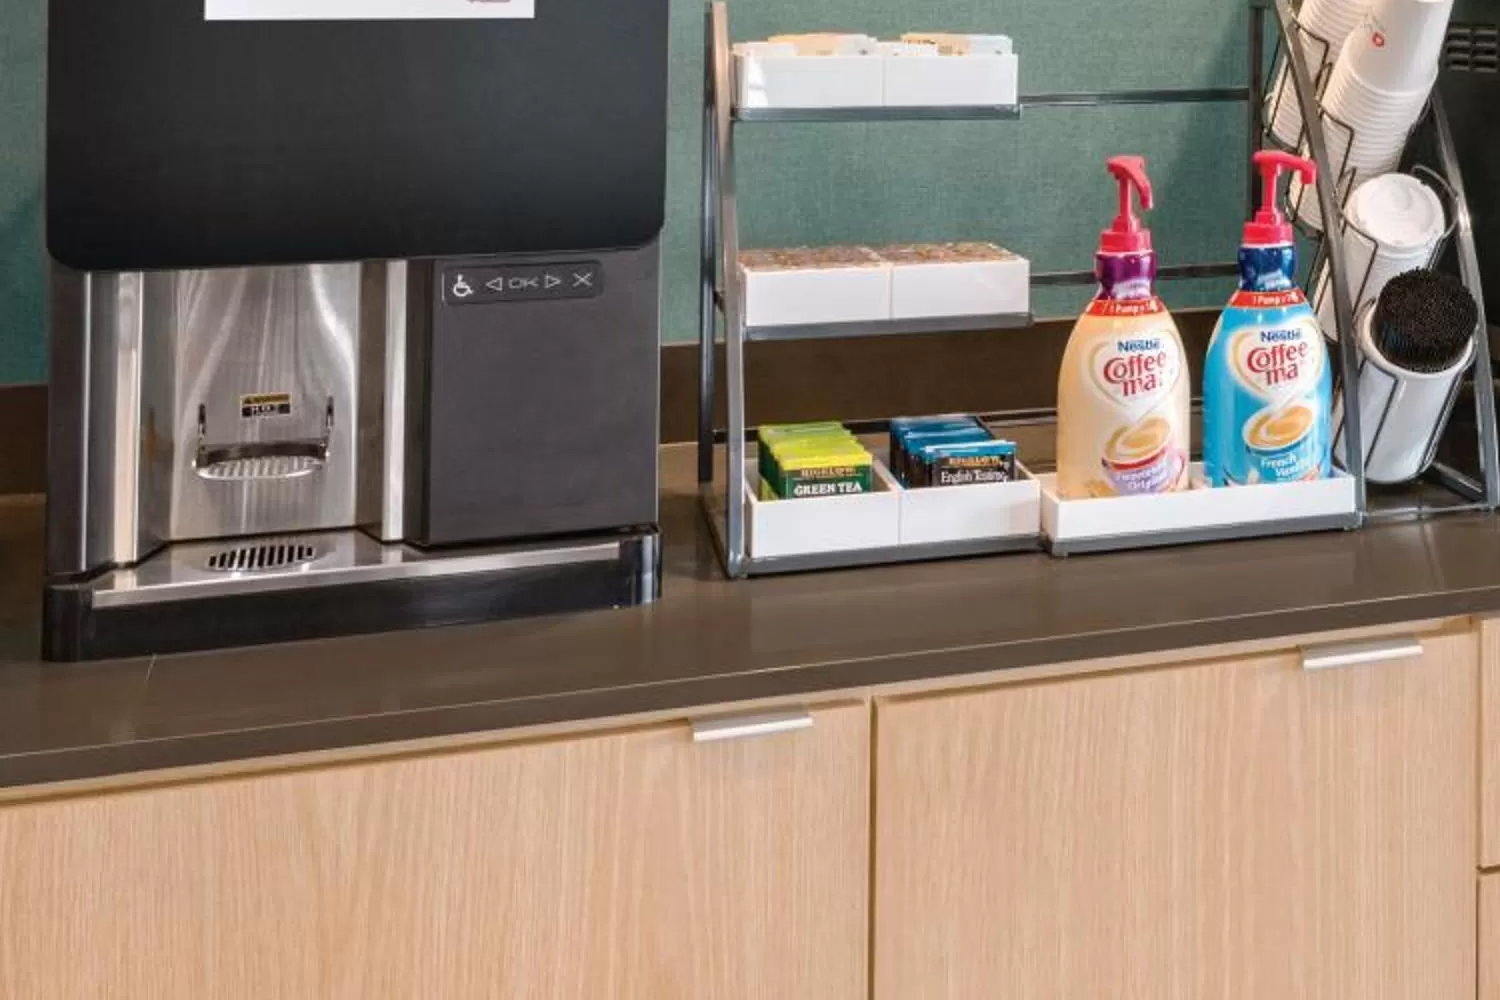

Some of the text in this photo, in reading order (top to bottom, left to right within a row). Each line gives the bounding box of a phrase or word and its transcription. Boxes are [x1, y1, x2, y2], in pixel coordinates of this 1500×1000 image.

[507, 275, 541, 291] OK
[1103, 351, 1167, 384] Coffee
[1246, 342, 1309, 374] Coffee
[793, 481, 863, 497] GREEN TEA
